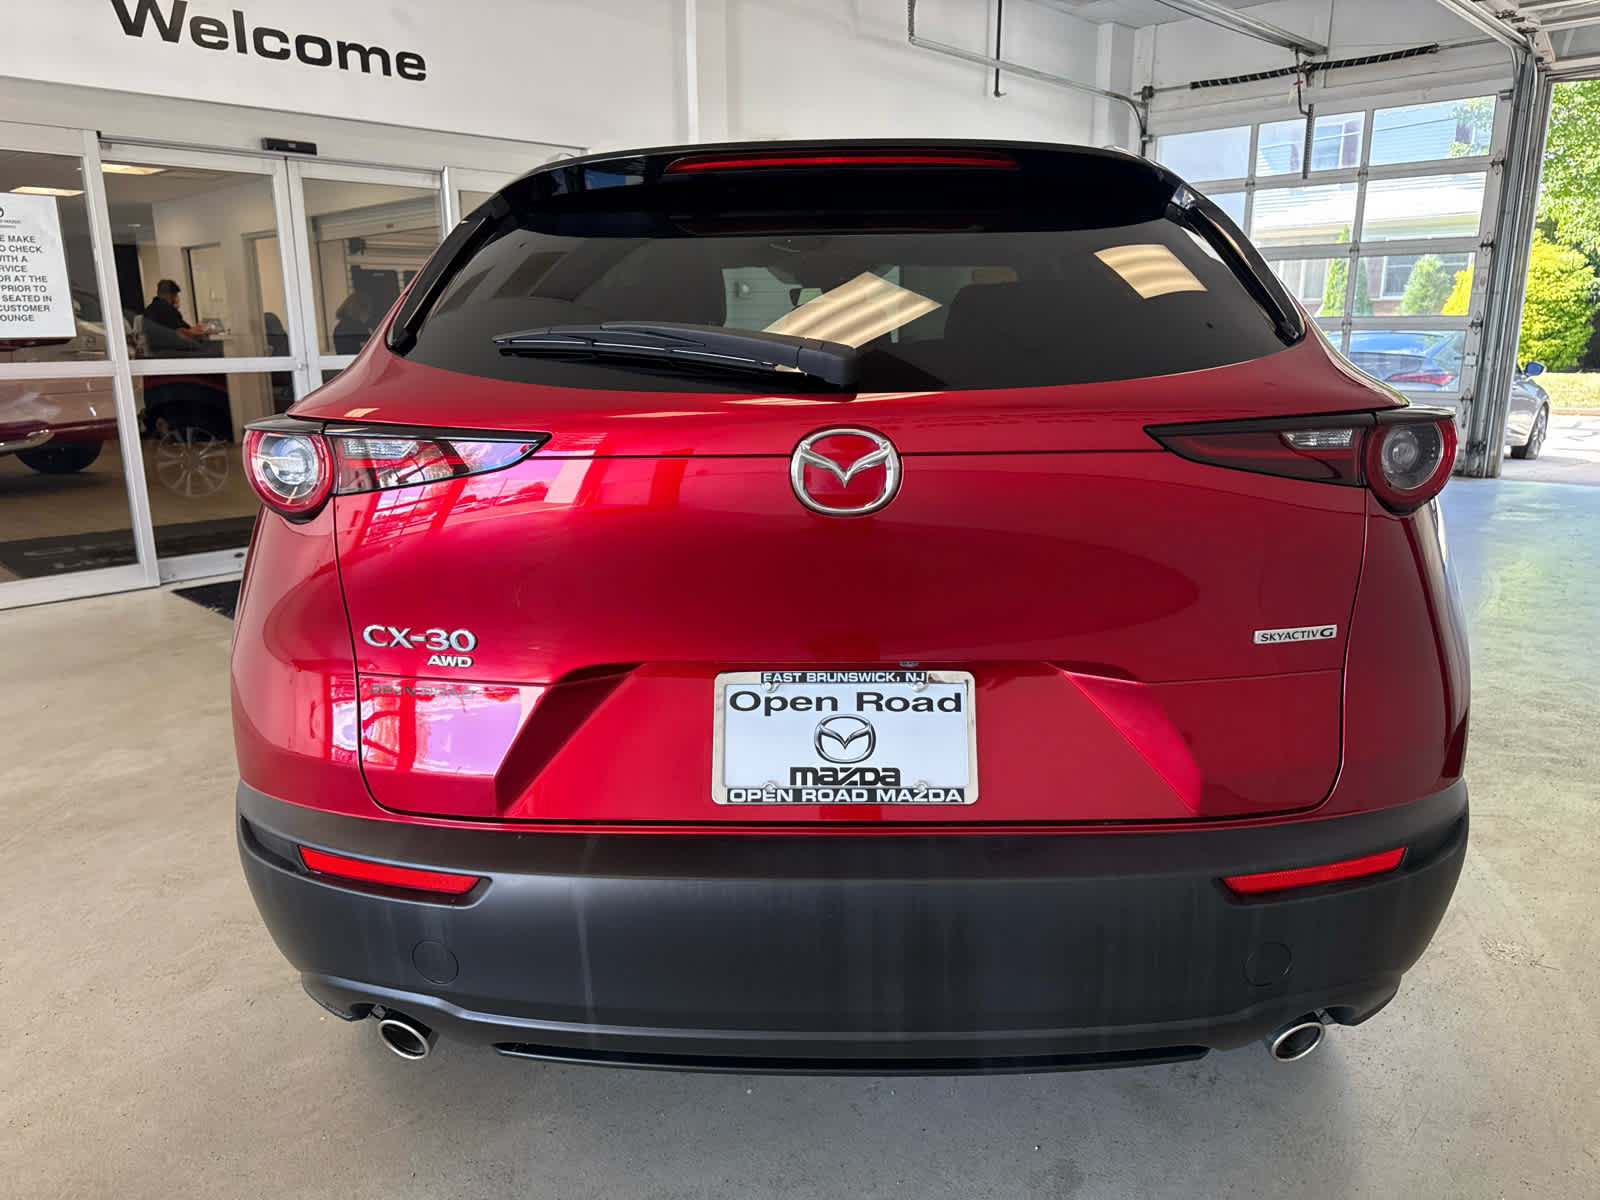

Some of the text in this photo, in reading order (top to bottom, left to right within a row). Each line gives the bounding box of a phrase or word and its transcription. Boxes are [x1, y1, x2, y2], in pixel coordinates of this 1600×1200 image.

[111, 0, 427, 81] Welcome
[8, 235, 37, 243] MAKE
[9, 245, 43, 253] CHECK
[22, 255, 28, 263] A
[0, 265, 28, 273] RVICE
[29, 275, 48, 283] THE
[1, 285, 47, 293] PRIOR TO
[2, 294, 41, 302] SEATED
[0, 314, 35, 322] OUNGE
[362, 624, 478, 652] CX-30
[427, 654, 474, 668] AWD
[763, 672, 926, 683] EAST BRUNSWICK, NJ
[729, 690, 962, 716] Open Road
[790, 766, 901, 787] mazda
[730, 788, 963, 802] OPEN ROAD MAZDA
